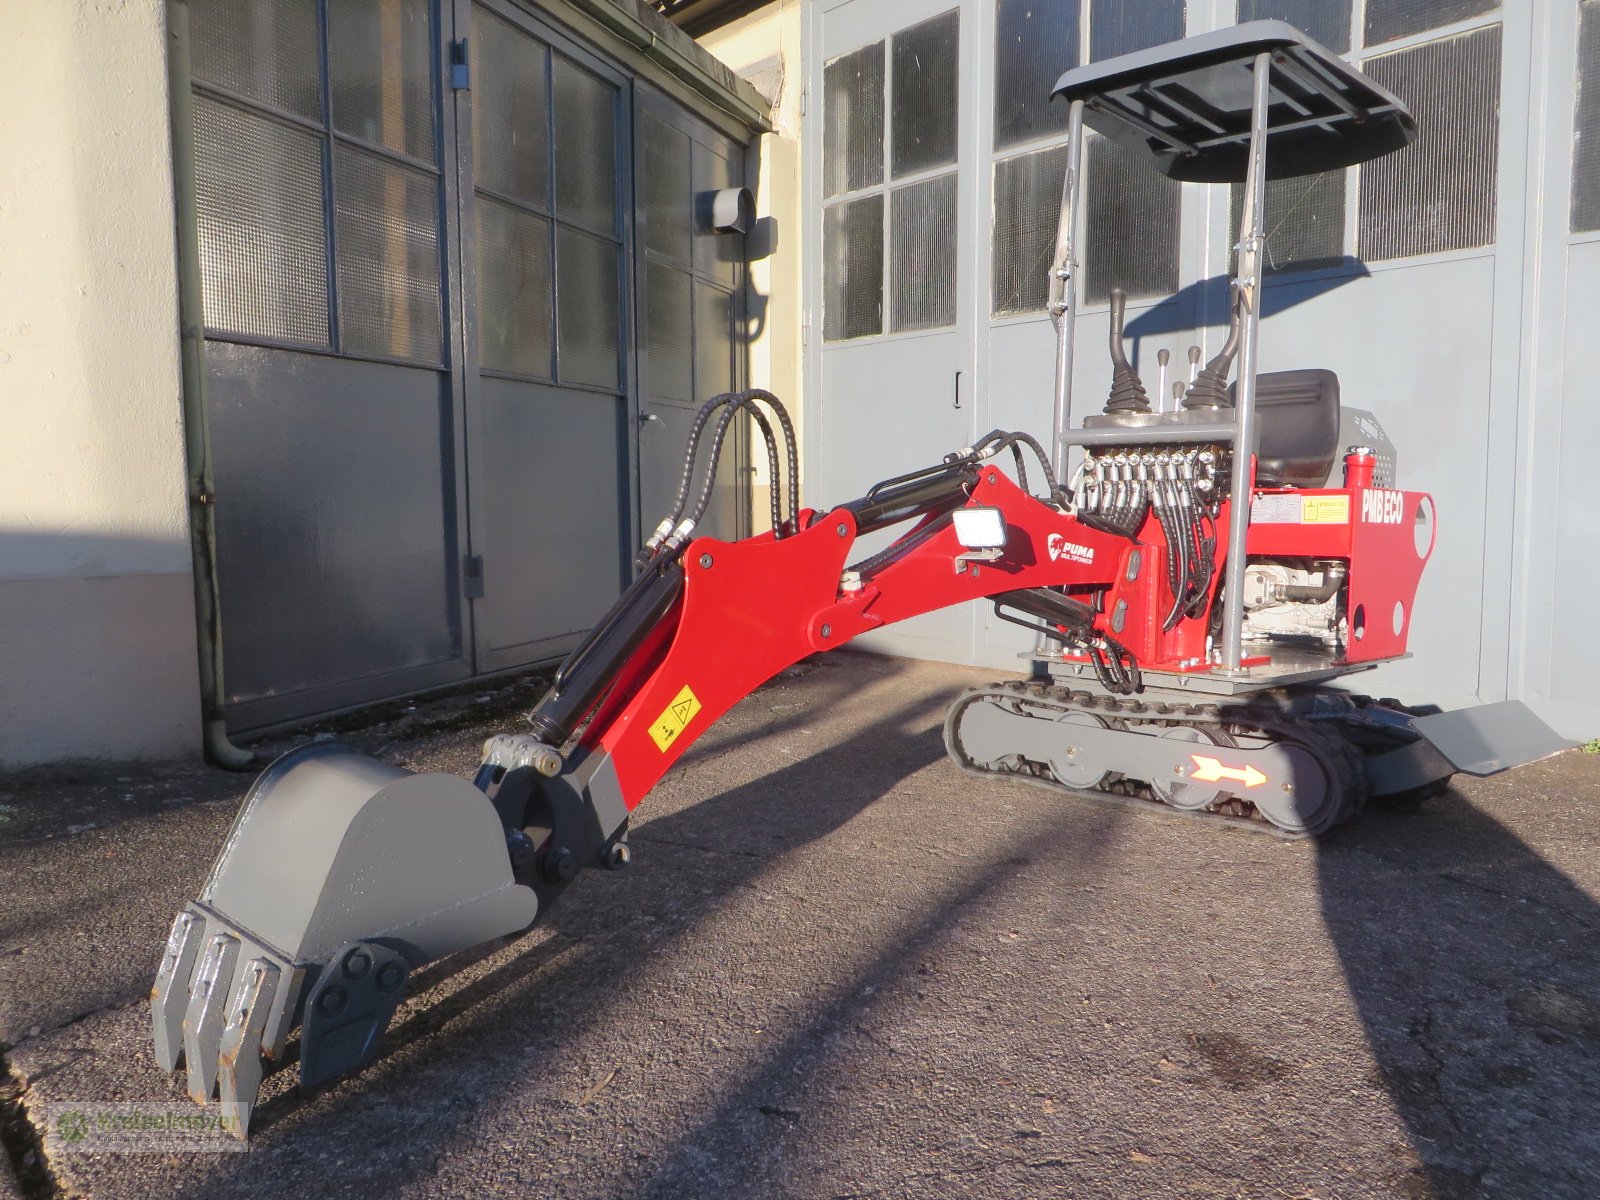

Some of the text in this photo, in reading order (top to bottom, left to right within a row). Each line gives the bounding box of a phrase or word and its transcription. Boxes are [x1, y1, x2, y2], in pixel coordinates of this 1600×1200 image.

[1361, 488, 1404, 524] PMB ECO
[1062, 541, 1095, 559] PUMA
